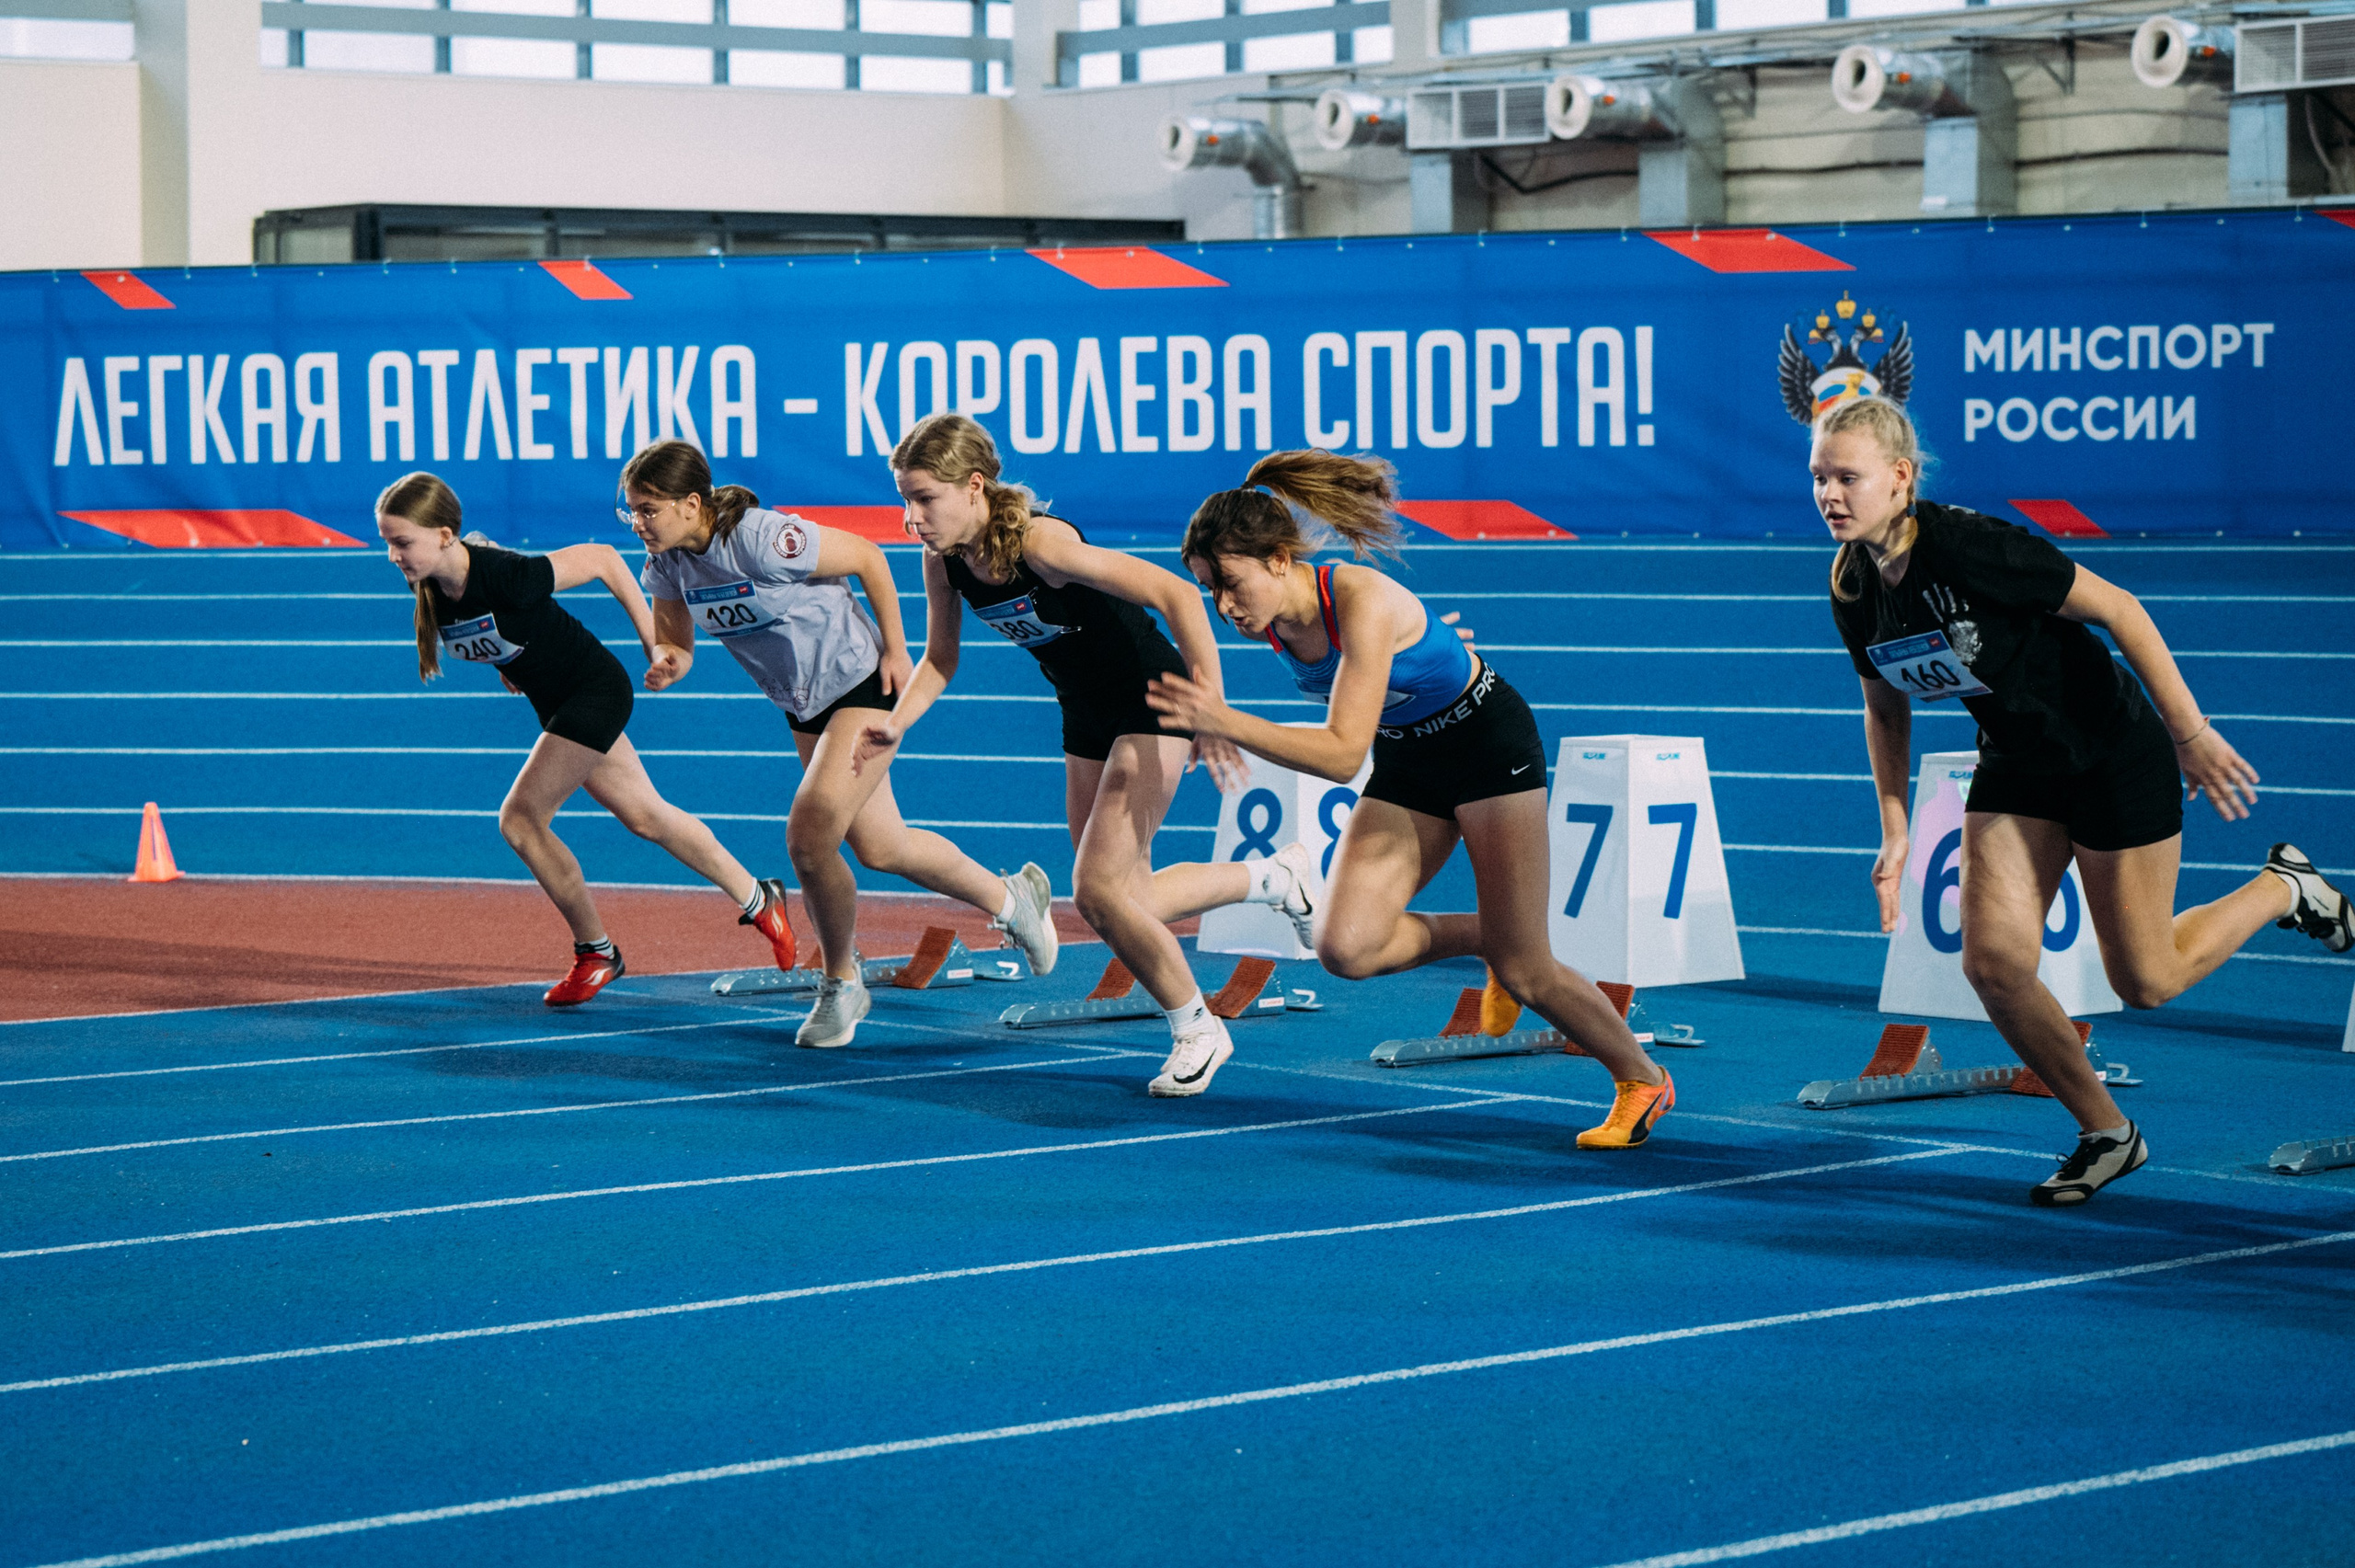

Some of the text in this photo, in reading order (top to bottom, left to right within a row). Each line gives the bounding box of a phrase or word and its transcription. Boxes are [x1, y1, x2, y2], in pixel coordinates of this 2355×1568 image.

[1964, 322, 2275, 372] МИНСПОРТ
[53, 350, 340, 466] ЛЕГКАЯ
[369, 344, 758, 463] АТЛЕТИКА
[844, 333, 1272, 456] КОРОЛЕВА
[1302, 325, 1656, 451] СПОРТА!
[1964, 395, 2197, 442] РОССИИ
[706, 602, 758, 628] 120
[454, 637, 502, 660] 240
[1900, 659, 1961, 690] 160
[1413, 699, 1473, 738] NIKE
[1472, 661, 1496, 706] PRO
[1231, 787, 1283, 863] 8
[1563, 803, 1614, 919] 7
[1648, 803, 1697, 920] 7
